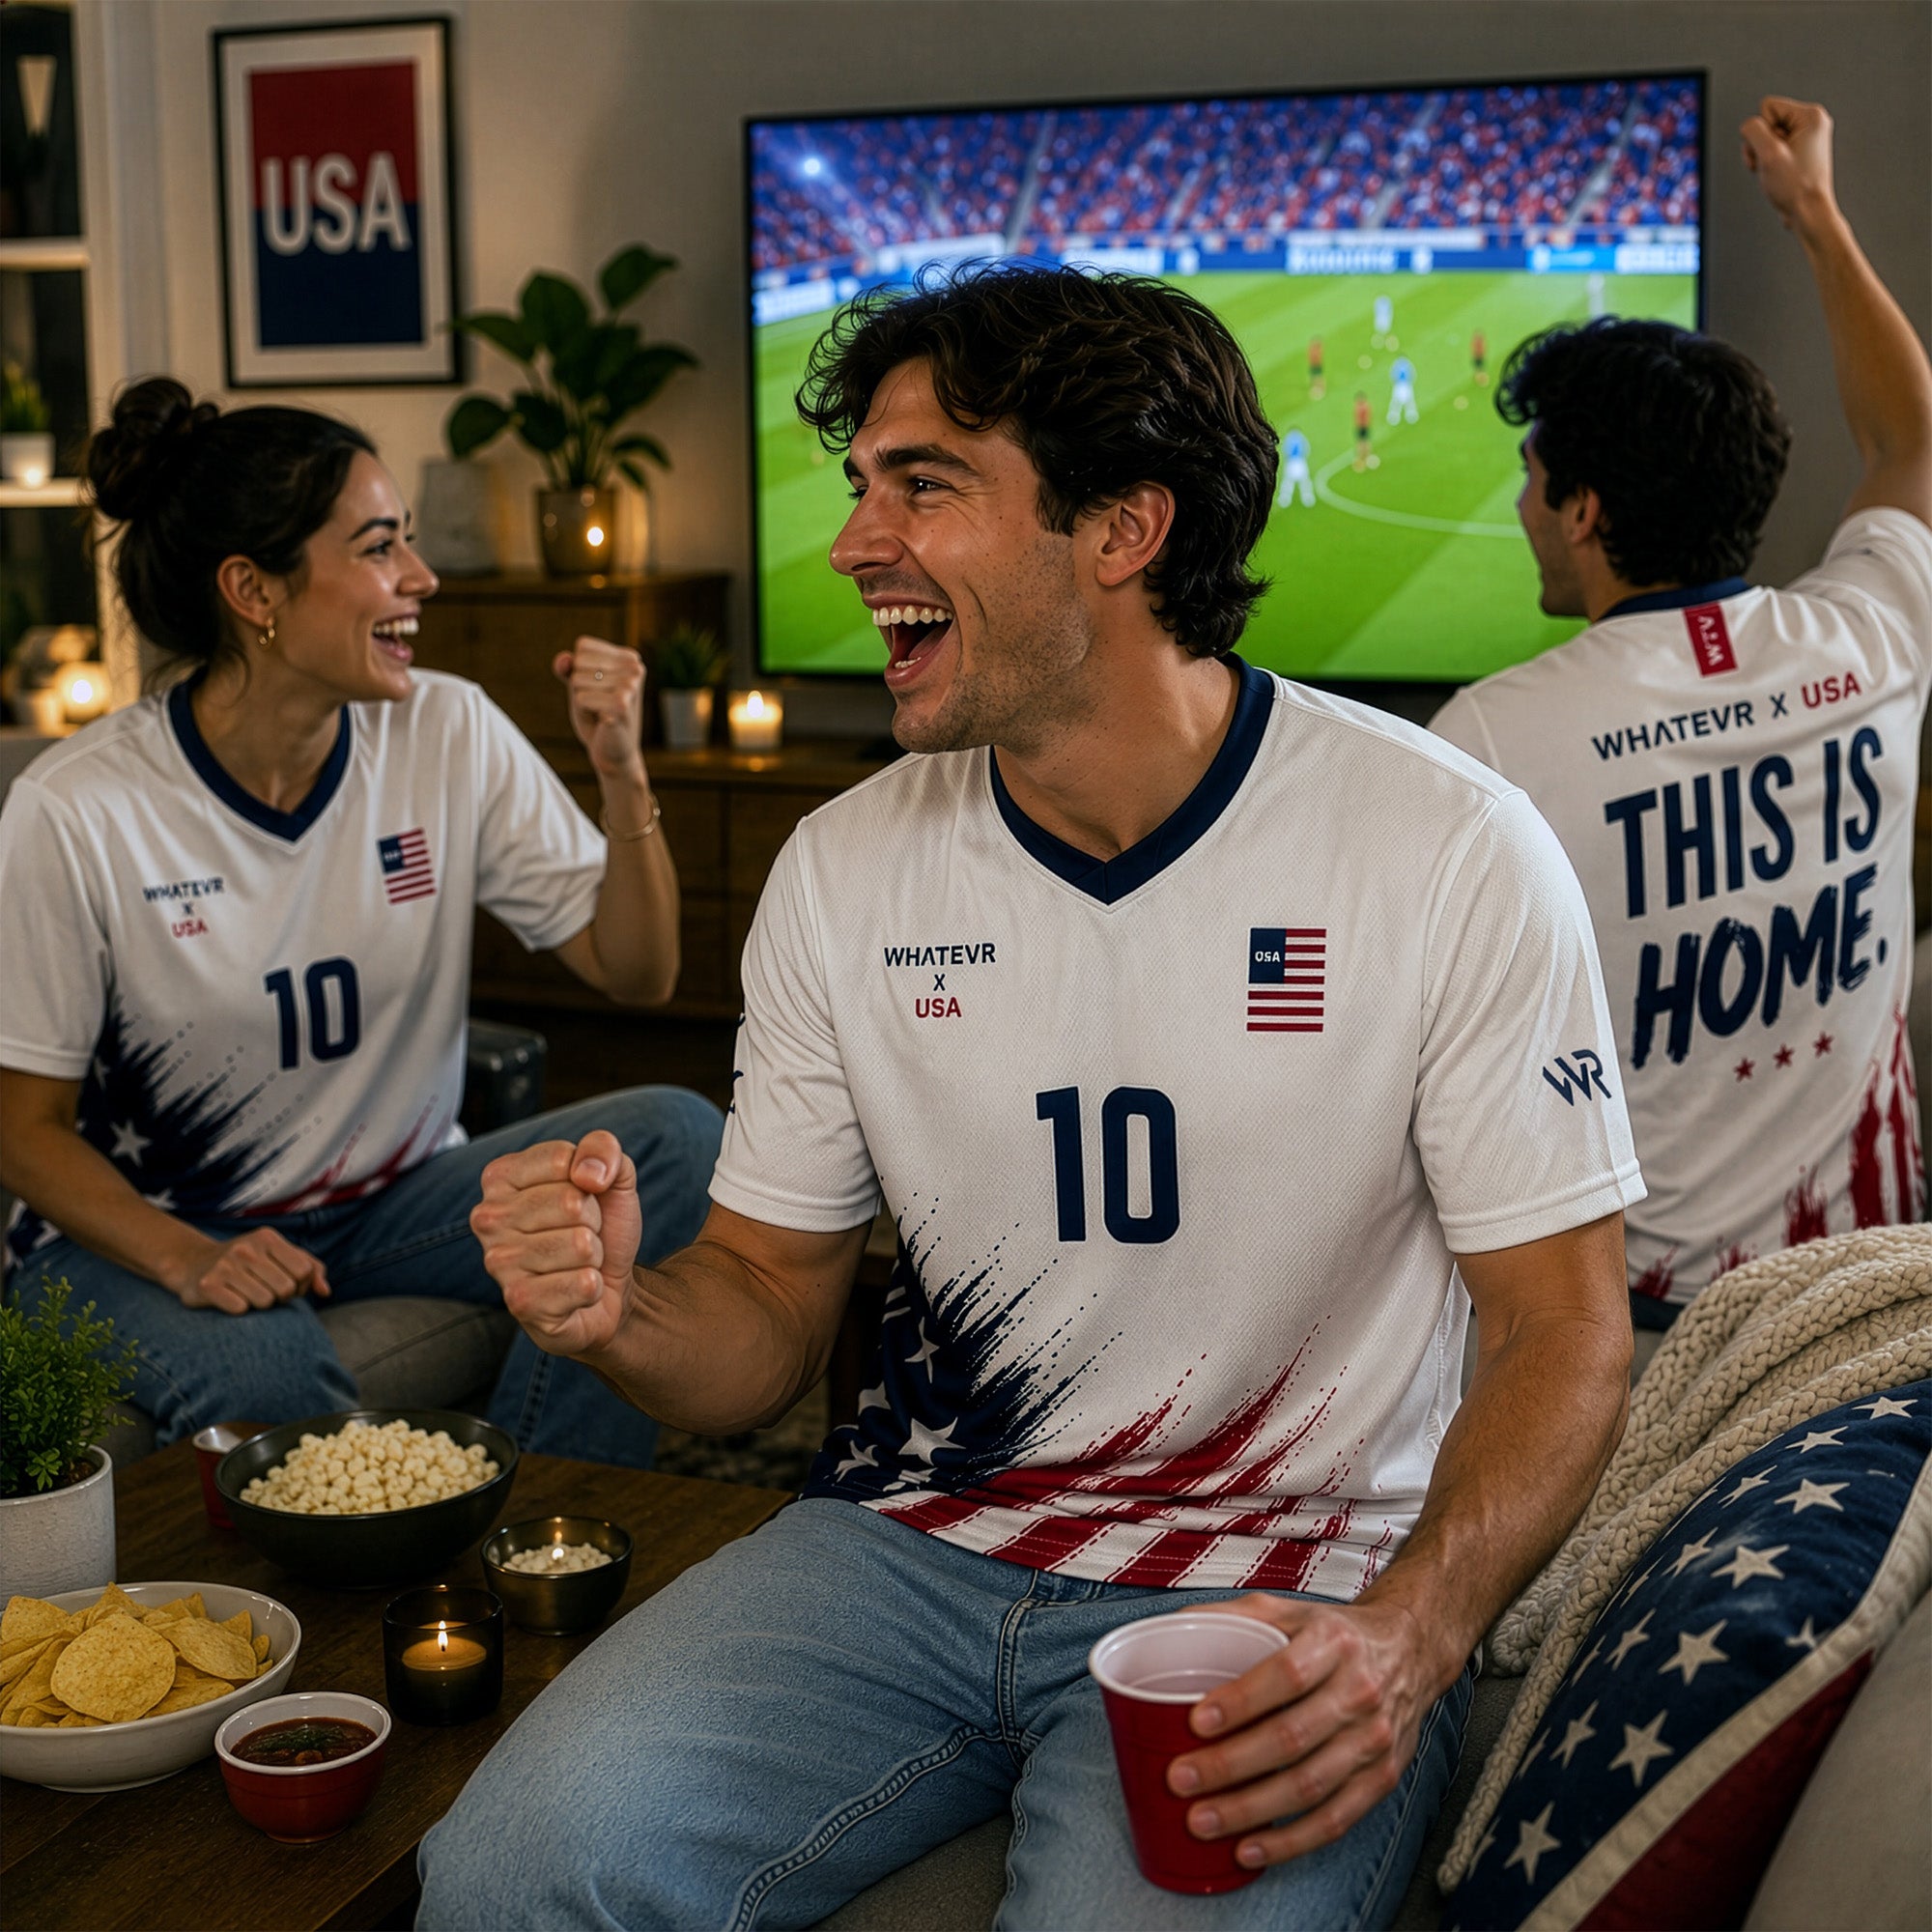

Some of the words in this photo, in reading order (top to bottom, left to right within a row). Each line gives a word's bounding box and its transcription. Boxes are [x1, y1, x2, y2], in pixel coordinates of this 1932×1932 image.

[261, 151, 412, 257] USA
[1800, 671, 1862, 709] USA
[1604, 753, 1794, 919] THIS
[1823, 726, 1882, 864] IS
[172, 918, 208, 938] USA
[1632, 862, 1887, 1069] HOME.
[263, 955, 361, 1070] 10
[915, 996, 962, 1018] USA
[1036, 1086, 1180, 1244] 10
